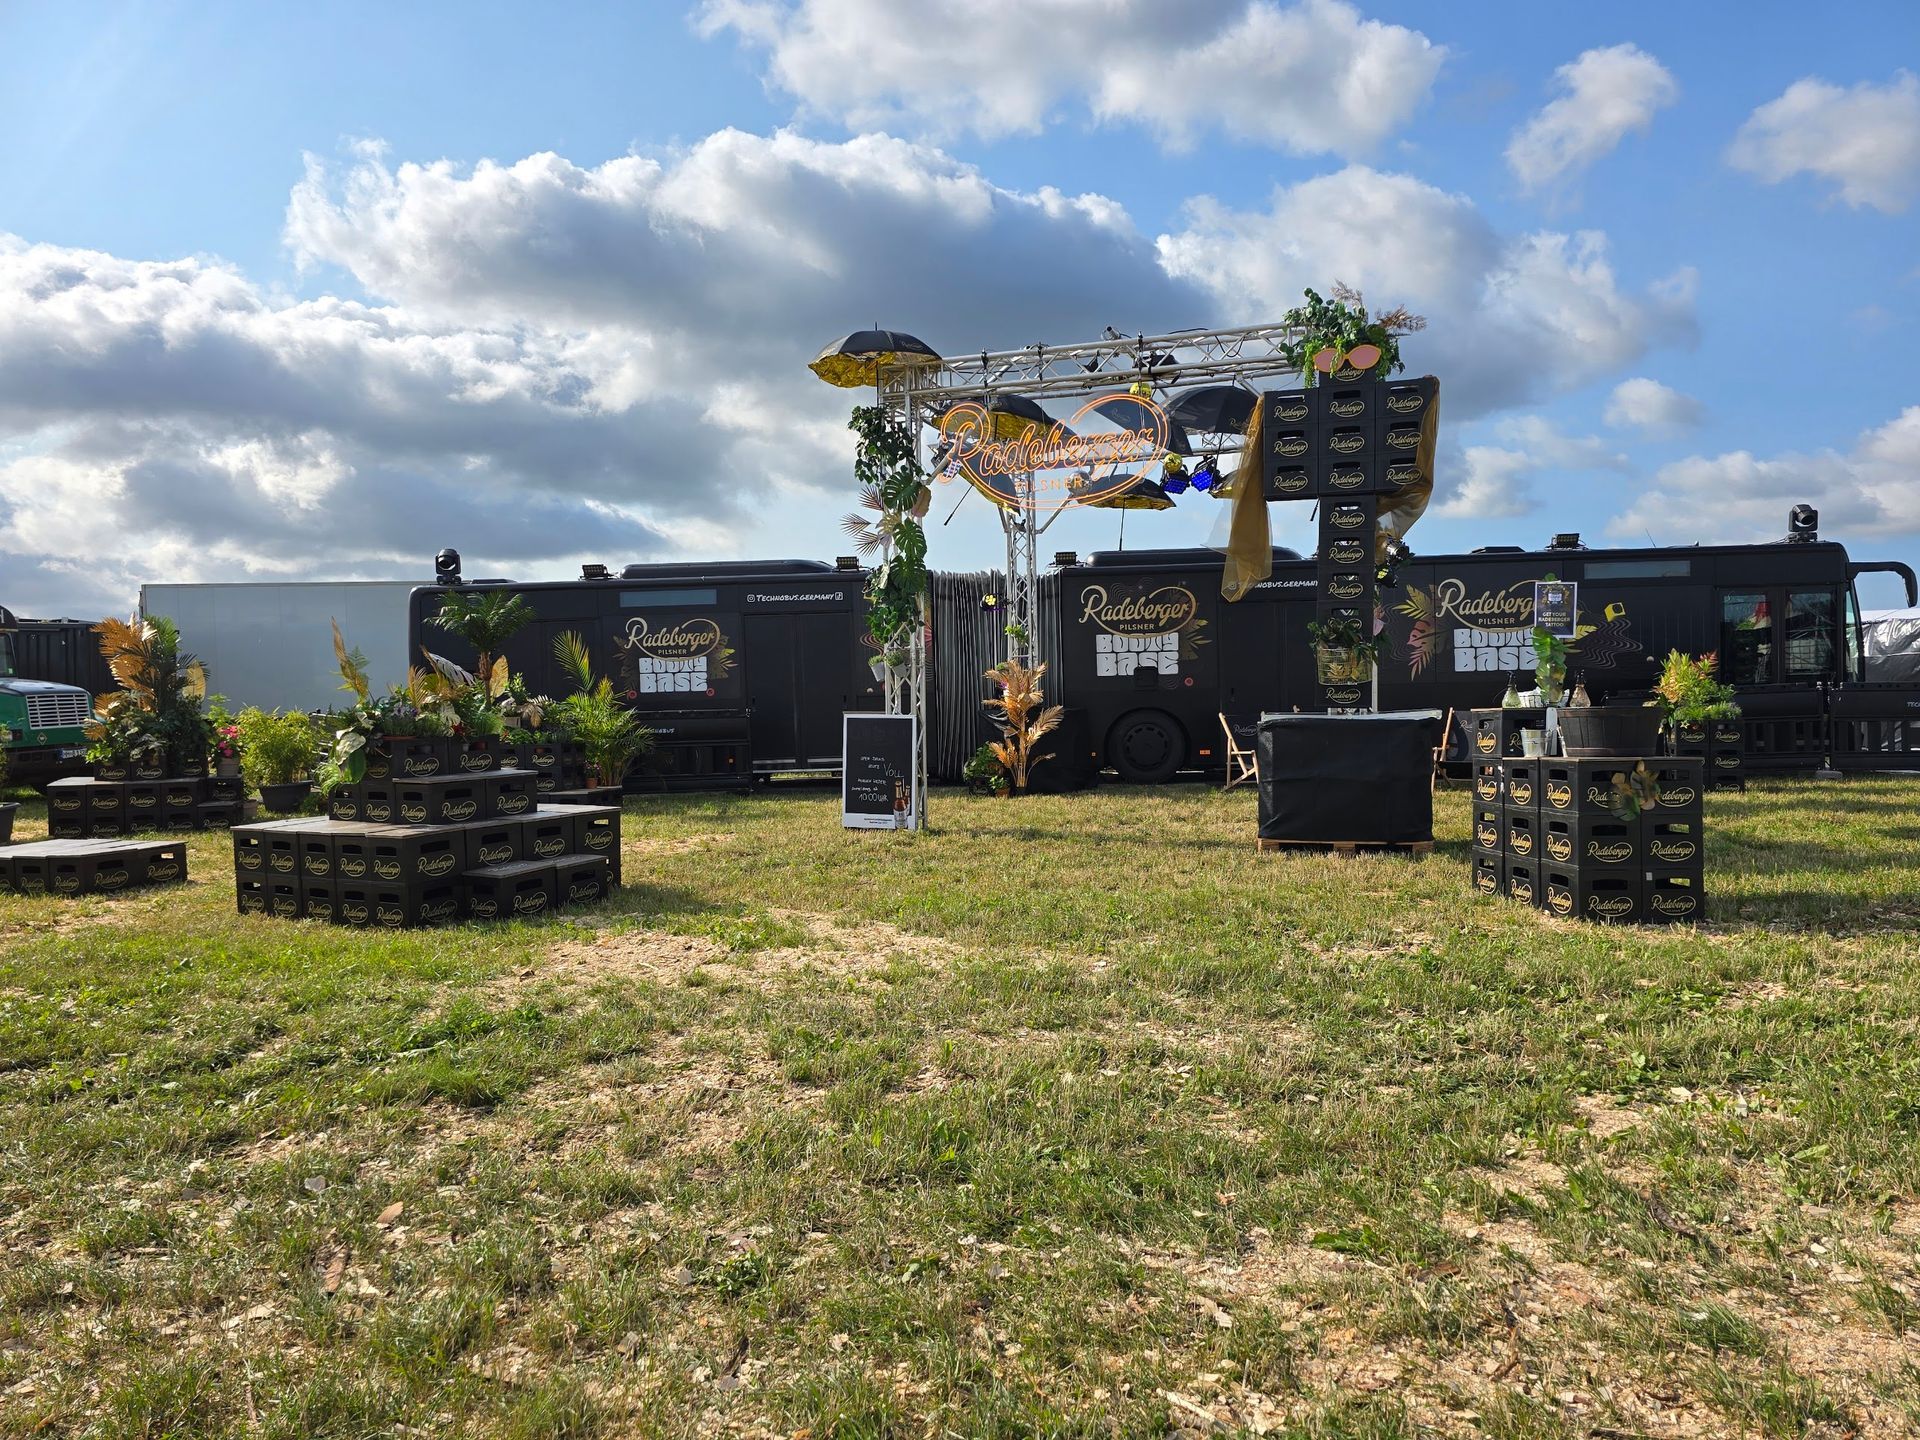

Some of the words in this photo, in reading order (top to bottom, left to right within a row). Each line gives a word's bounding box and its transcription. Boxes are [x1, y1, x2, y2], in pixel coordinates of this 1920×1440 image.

[1329, 401, 1365, 417] Radeberger
[1387, 396, 1423, 412] Radeberger
[1274, 405, 1308, 421] Radeberger
[939, 396, 1168, 503] Radeberger
[1274, 440, 1308, 456] Radeberger
[1329, 436, 1365, 453] Radeberger
[1274, 475, 1308, 491] Radeberger
[1329, 472, 1365, 488] Radeberger
[1330, 511, 1365, 528] Radeberger
[1328, 547, 1364, 563] Radeberger
[1328, 582, 1363, 599] Radeberger
[1079, 585, 1197, 636] Radeberger
[1436, 578, 1535, 631] Radeberg
[1119, 623, 1155, 631] PILSNER
[1478, 617, 1516, 625] PILSNER
[624, 617, 720, 659] Radeberger
[639, 672, 708, 693] BASE
[1326, 687, 1361, 704] Radeberger
[1659, 787, 1694, 806] deberger
[1587, 841, 1633, 861] Radeberger
[1650, 840, 1695, 861] Radeberger
[1588, 896, 1633, 916] Radeberger
[1651, 895, 1696, 915] Radeberger
